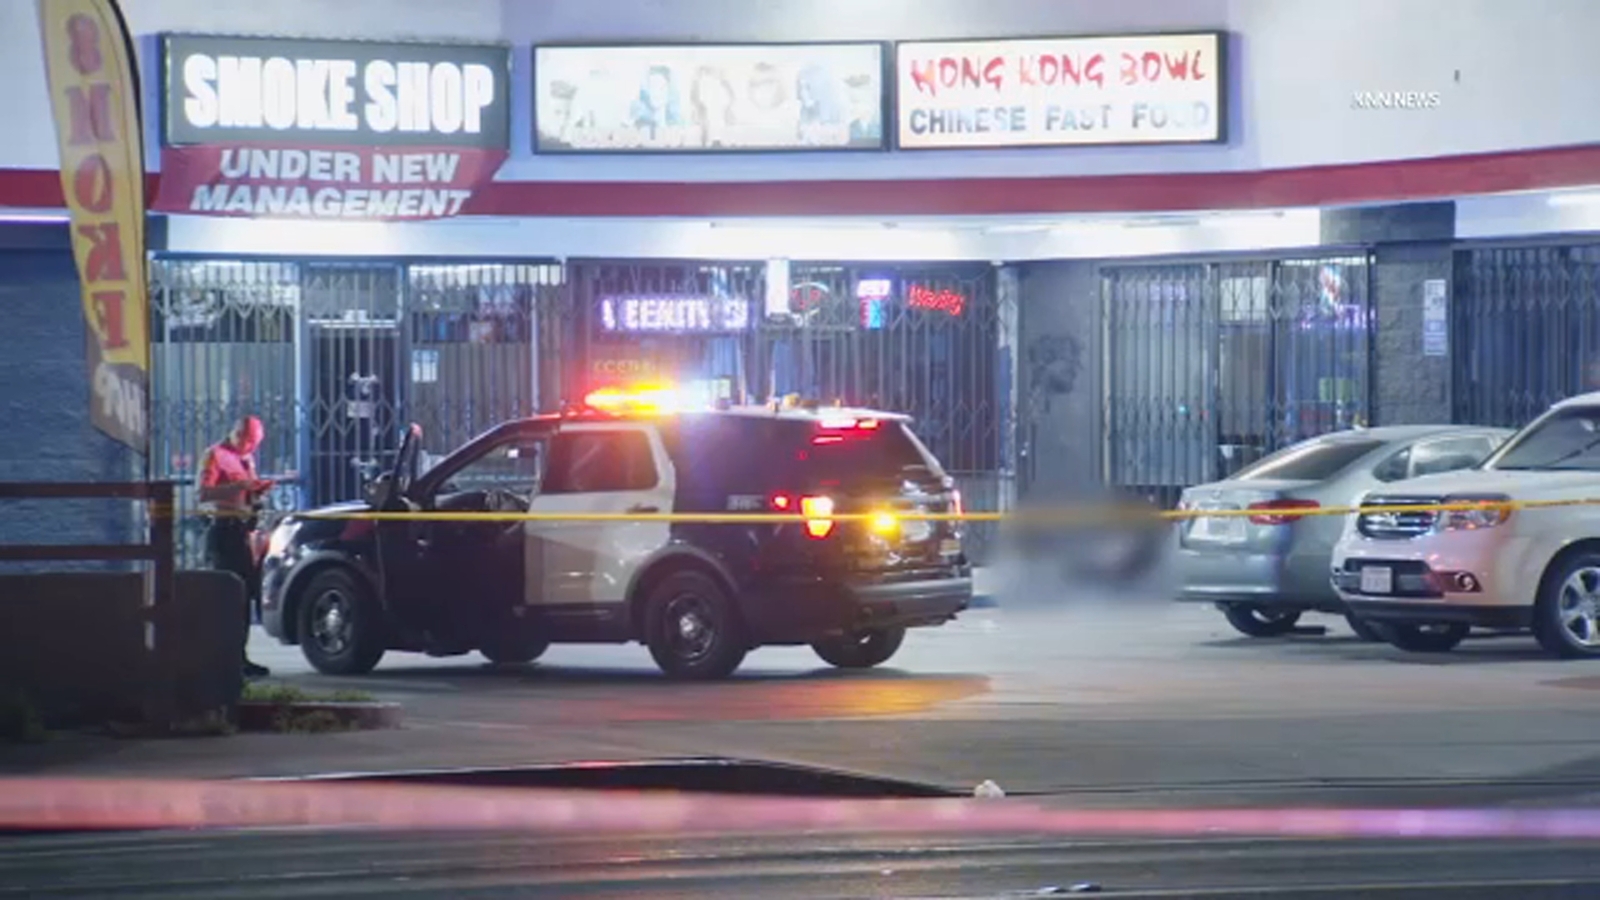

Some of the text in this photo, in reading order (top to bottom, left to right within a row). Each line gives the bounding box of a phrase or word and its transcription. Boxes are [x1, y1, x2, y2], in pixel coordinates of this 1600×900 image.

[910, 50, 1206, 96] HONG KONG BOWL
[182, 53, 495, 133] SMOKE SHOP
[909, 106, 1027, 135] CHINESE
[1045, 104, 1112, 131] FAST
[219, 148, 460, 184] UNDER NEW
[189, 185, 472, 218] MANAGEMENT
